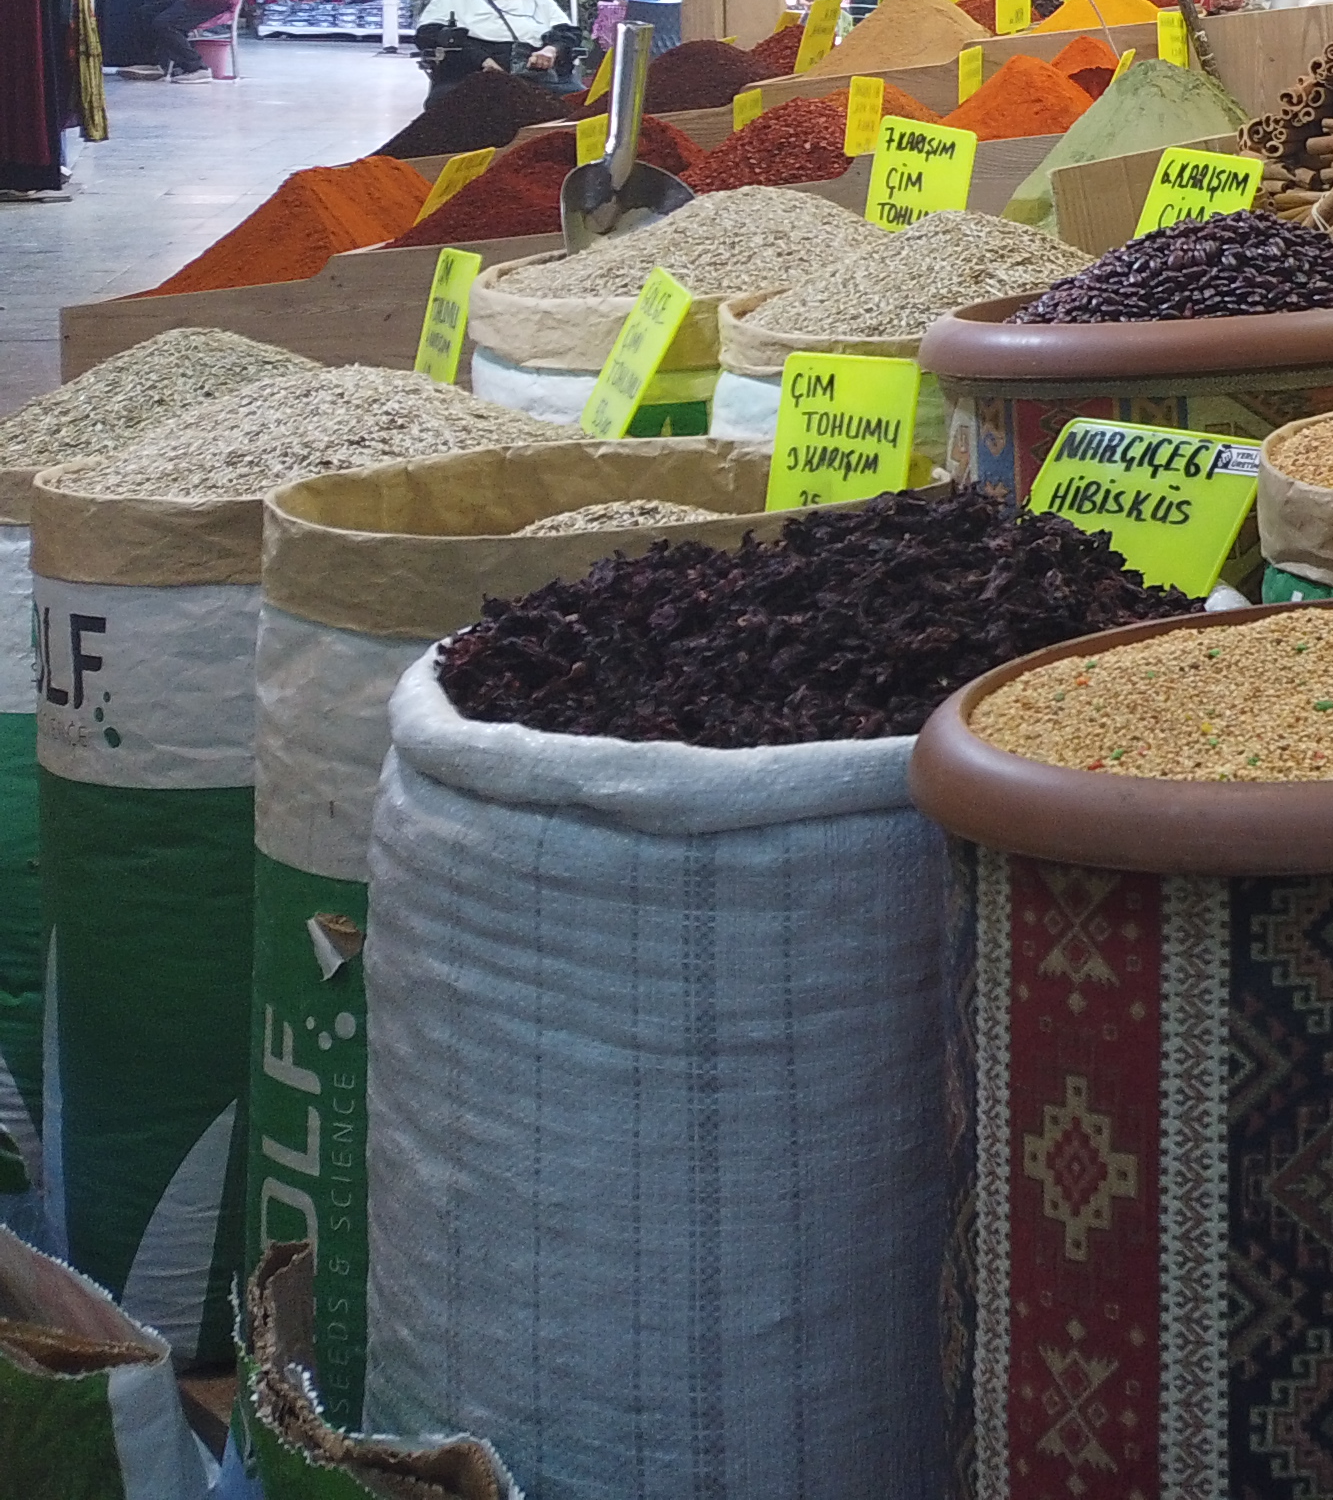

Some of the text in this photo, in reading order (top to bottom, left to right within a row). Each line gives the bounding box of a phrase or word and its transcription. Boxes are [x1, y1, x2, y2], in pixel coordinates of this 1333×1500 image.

[886, 163, 923, 199] ÇİM
[877, 202, 936, 226] TOHU
[791, 366, 835, 410] ÇİM
[801, 410, 901, 448] TOHUMU
[801, 446, 880, 481] KARIŞIM
[1049, 475, 1192, 525] HİBİSKÜS
[330, 1072, 355, 1233] SCIENCE
